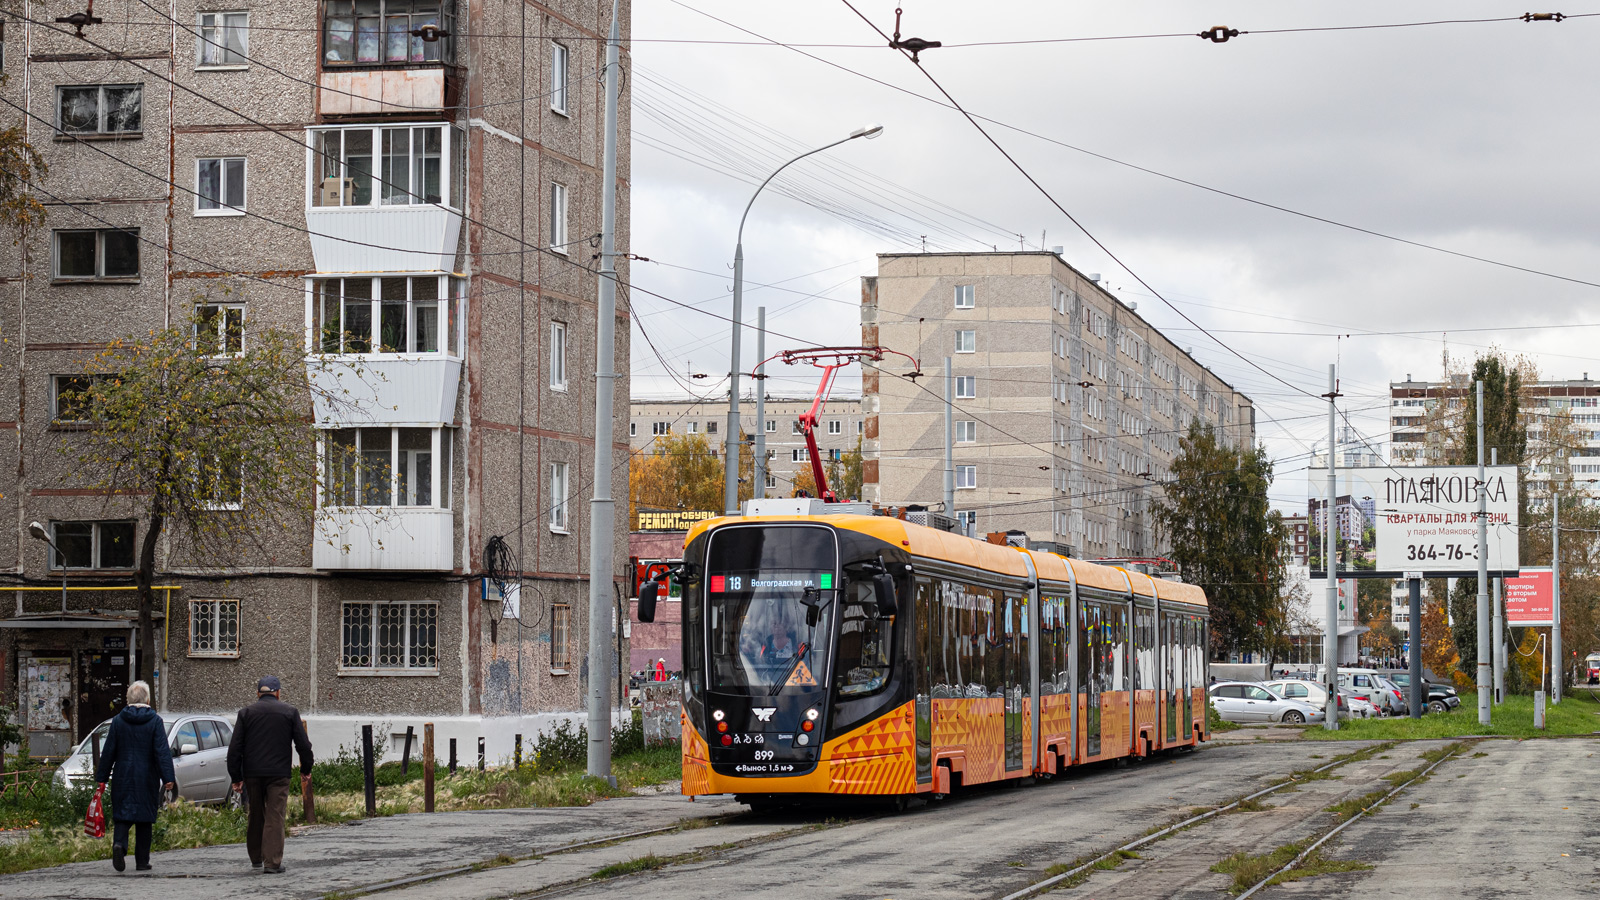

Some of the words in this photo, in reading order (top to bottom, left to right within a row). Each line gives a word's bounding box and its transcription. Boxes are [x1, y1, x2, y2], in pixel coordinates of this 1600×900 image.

[639, 513, 680, 529] РЕМОНТ
[682, 511, 715, 520] ОБУВИ
[1387, 514, 1442, 523] КВАРТАЛЫ
[1445, 513, 1467, 524] ДЛЯ
[1470, 512, 1508, 523] ЖЗНИ
[1407, 529, 1412, 537] у
[1413, 529, 1437, 537] парка
[729, 576, 741, 590] 18
[751, 578, 802, 588] Волгоградская
[804, 579, 815, 587] ул.
[754, 750, 774, 761] 899
[768, 764, 779, 772] 1,5
